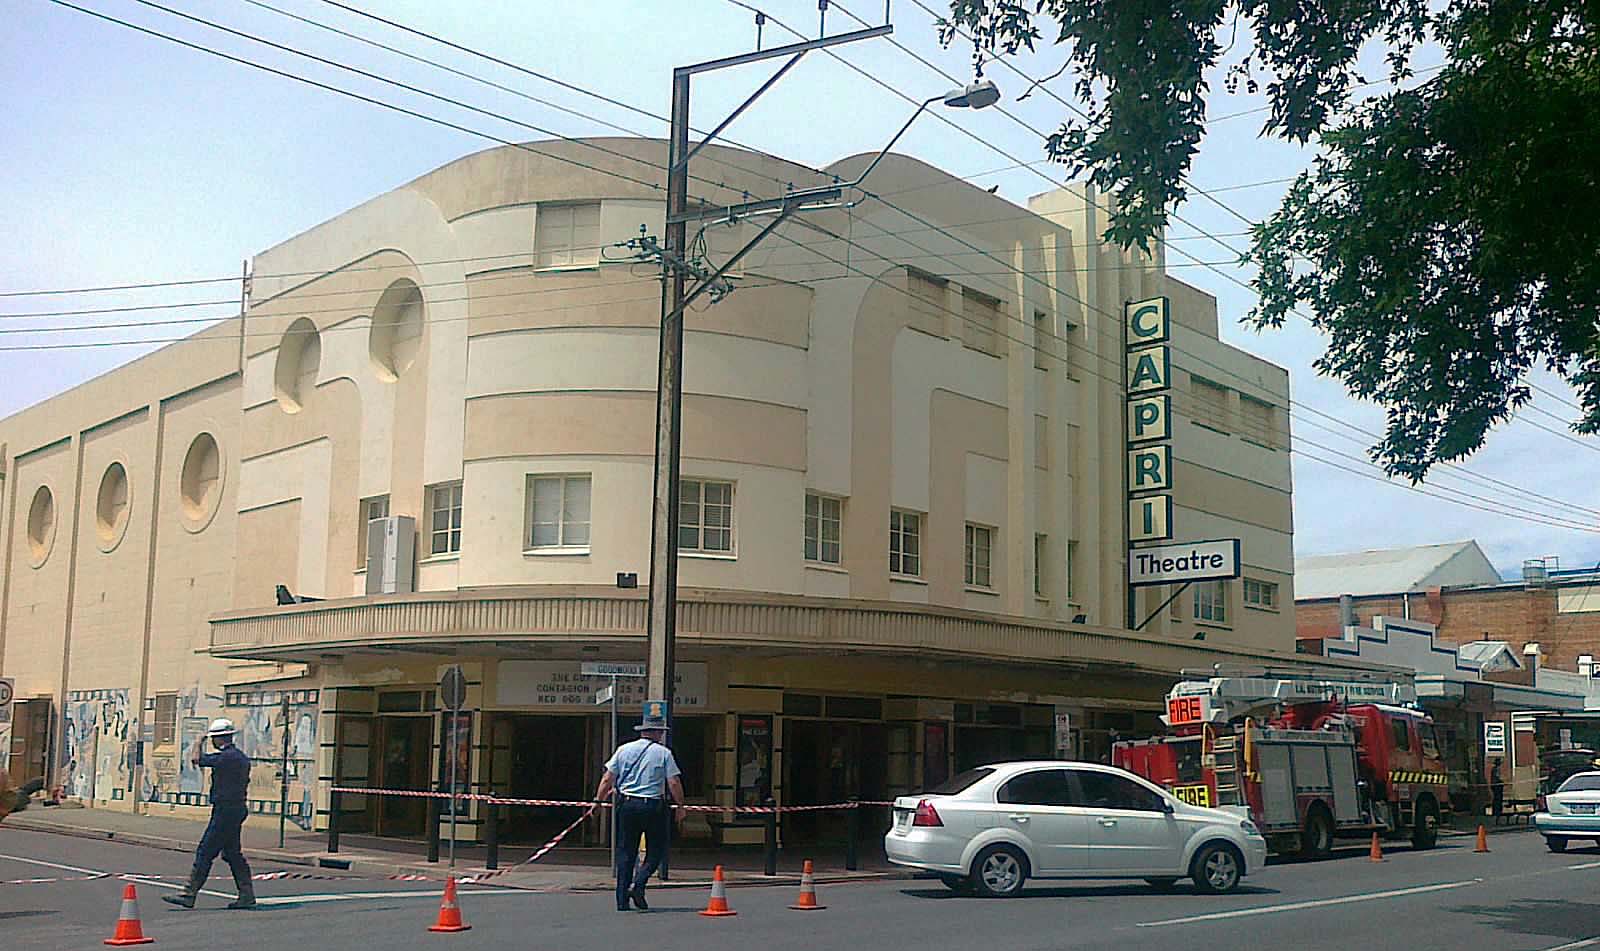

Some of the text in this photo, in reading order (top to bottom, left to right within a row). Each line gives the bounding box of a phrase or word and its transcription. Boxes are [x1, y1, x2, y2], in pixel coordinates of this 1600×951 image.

[1130, 305, 1162, 535] CAPRI
[1136, 551, 1224, 575] Theatre
[536, 684, 590, 693] CONTAGION
[538, 696, 556, 704] RED
[562, 696, 581, 704] DOG
[1169, 697, 1202, 723] FIRE
[1176, 787, 1206, 808] FIRE
